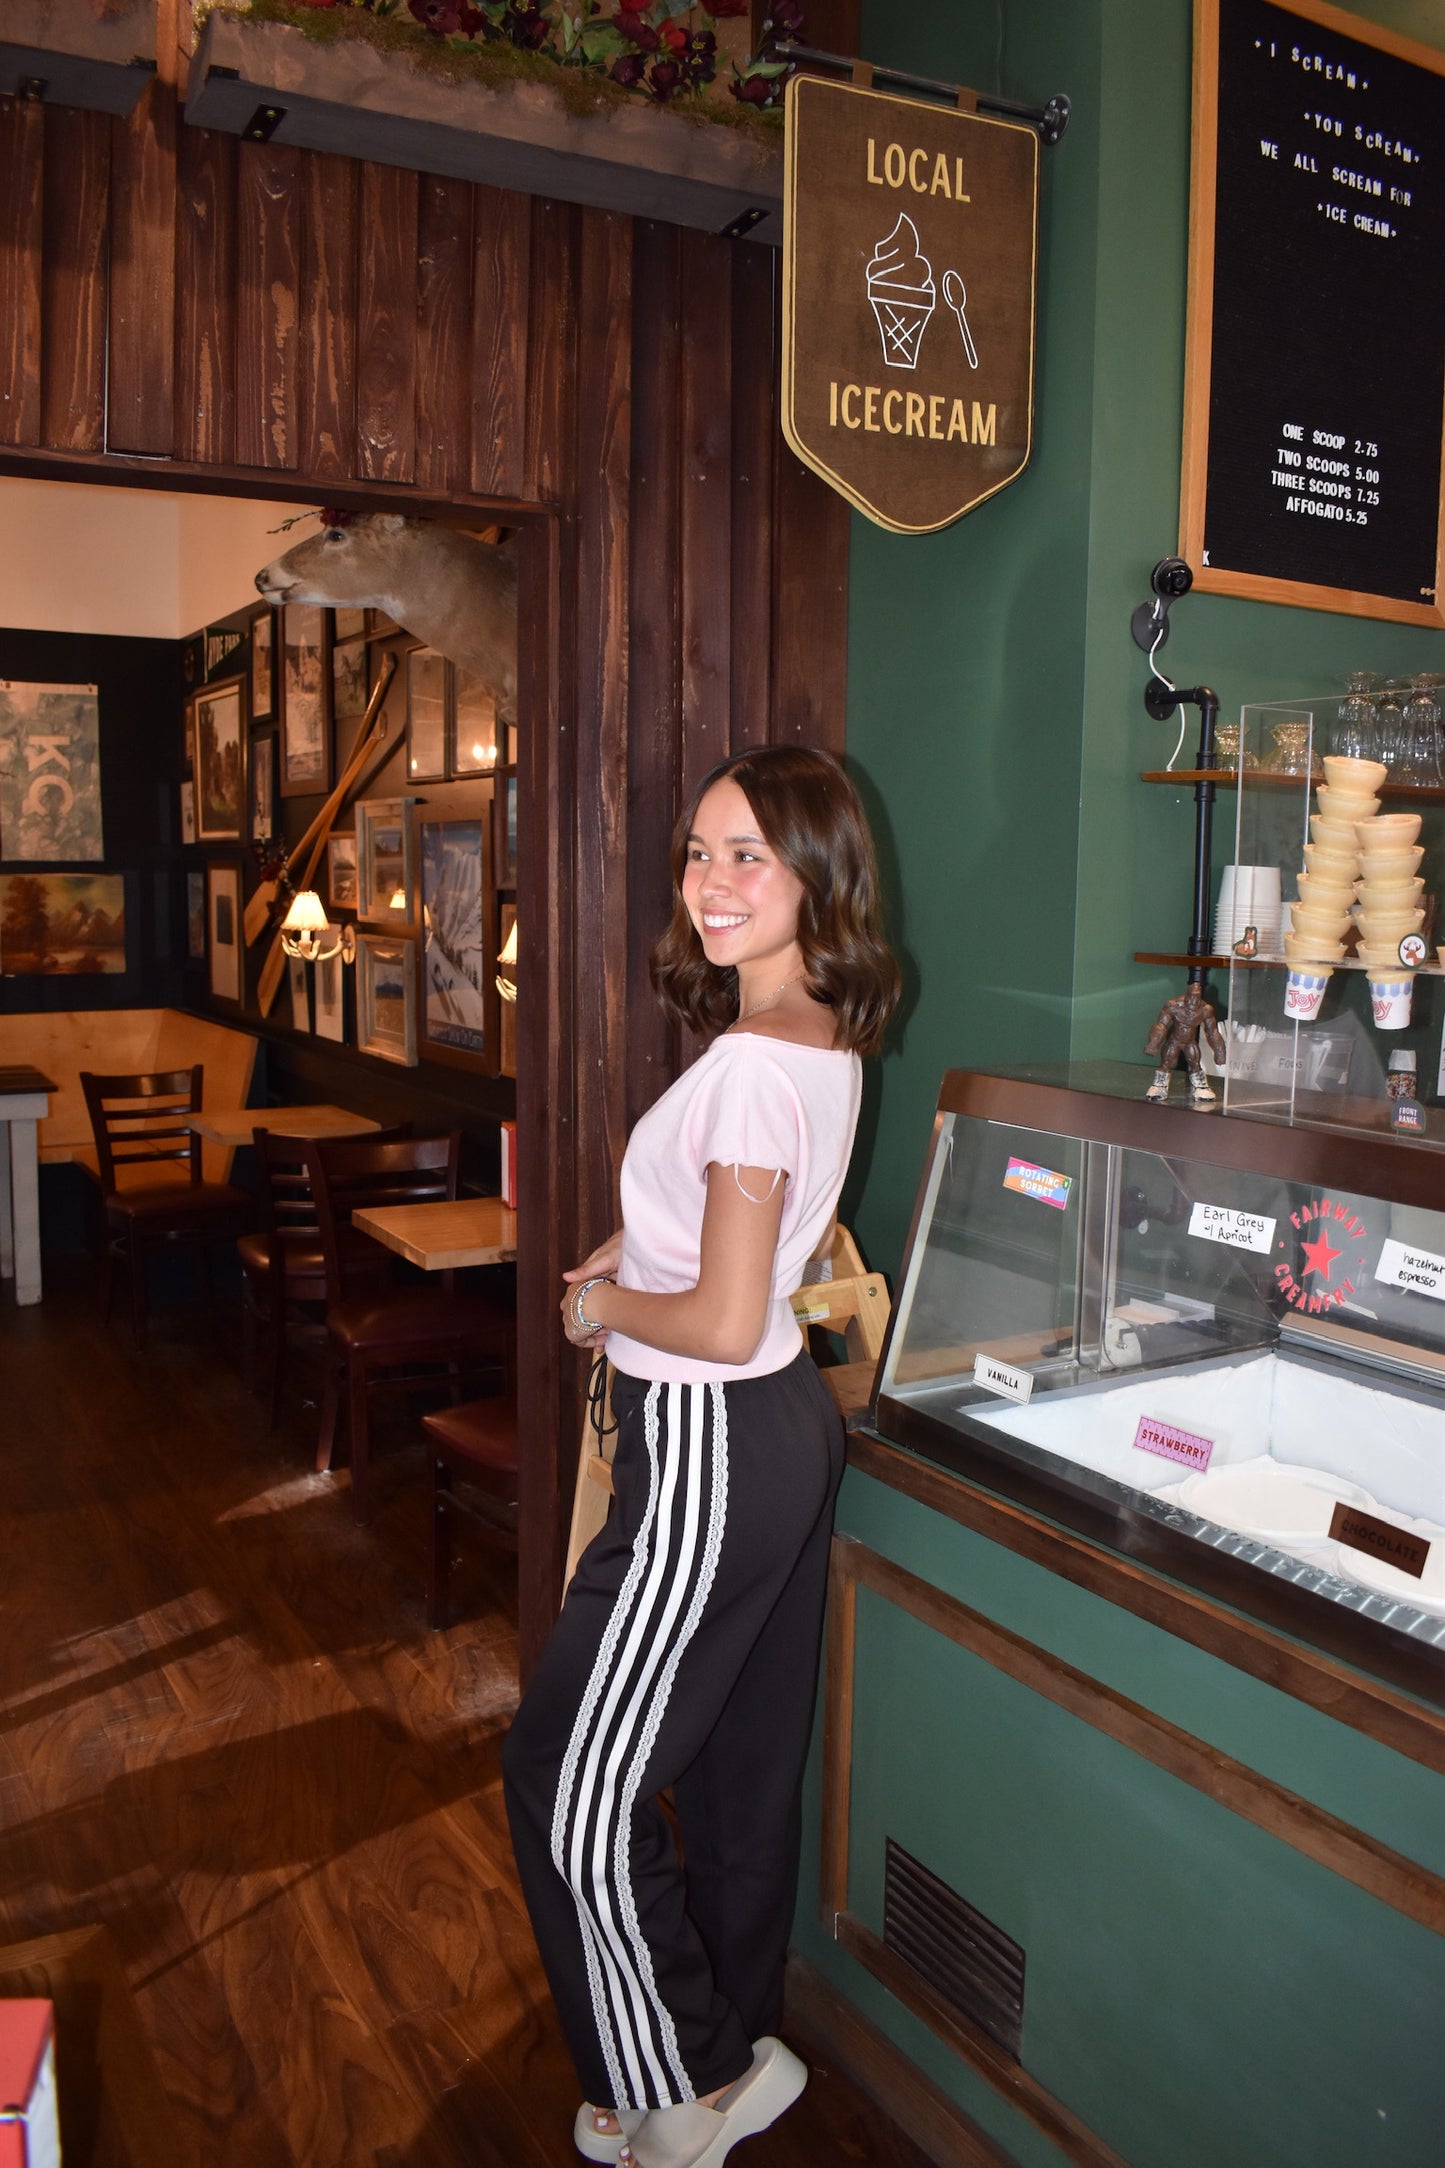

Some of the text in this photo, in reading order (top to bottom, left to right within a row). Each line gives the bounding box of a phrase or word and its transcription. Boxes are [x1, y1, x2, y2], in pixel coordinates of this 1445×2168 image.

[1270, 43, 1356, 90] I SCREAM
[1315, 113, 1412, 163] YOU SCREAM
[866, 138, 971, 203] LOCAL
[1260, 140, 1412, 207] WE ALL SCREAM FOR
[1353, 214, 1390, 239] CREAM
[828, 382, 997, 447] ICECREAM
[1283, 423, 1378, 458] ONE SCOOP 2.75
[1277, 449, 1380, 485] TWO SCOOPS 5.00
[1271, 470, 1380, 506] THREE SCOOPS 7.25
[1286, 496, 1368, 526] AFFOGATO 5.25
[1202, 550, 1210, 566] K
[1372, 1000, 1392, 1021] oy
[1398, 1115, 1417, 1125] RANGE
[1399, 1107, 1417, 1116] FRONT
[1019, 1166, 1060, 1189] ROTATING
[1020, 1179, 1053, 1197] SORBET
[1203, 1206, 1264, 1232] Earl Grey
[1289, 1198, 1367, 1239] FAIRWAY
[1218, 1227, 1253, 1244] Apricot
[1274, 1263, 1356, 1314] CREAMERY
[1398, 1270, 1436, 1288] espresso
[987, 1368, 1019, 1390] VANILLA
[1141, 1428, 1206, 1460] STRAWBERRY
[1341, 1519, 1419, 1562] CHOCOLATE
